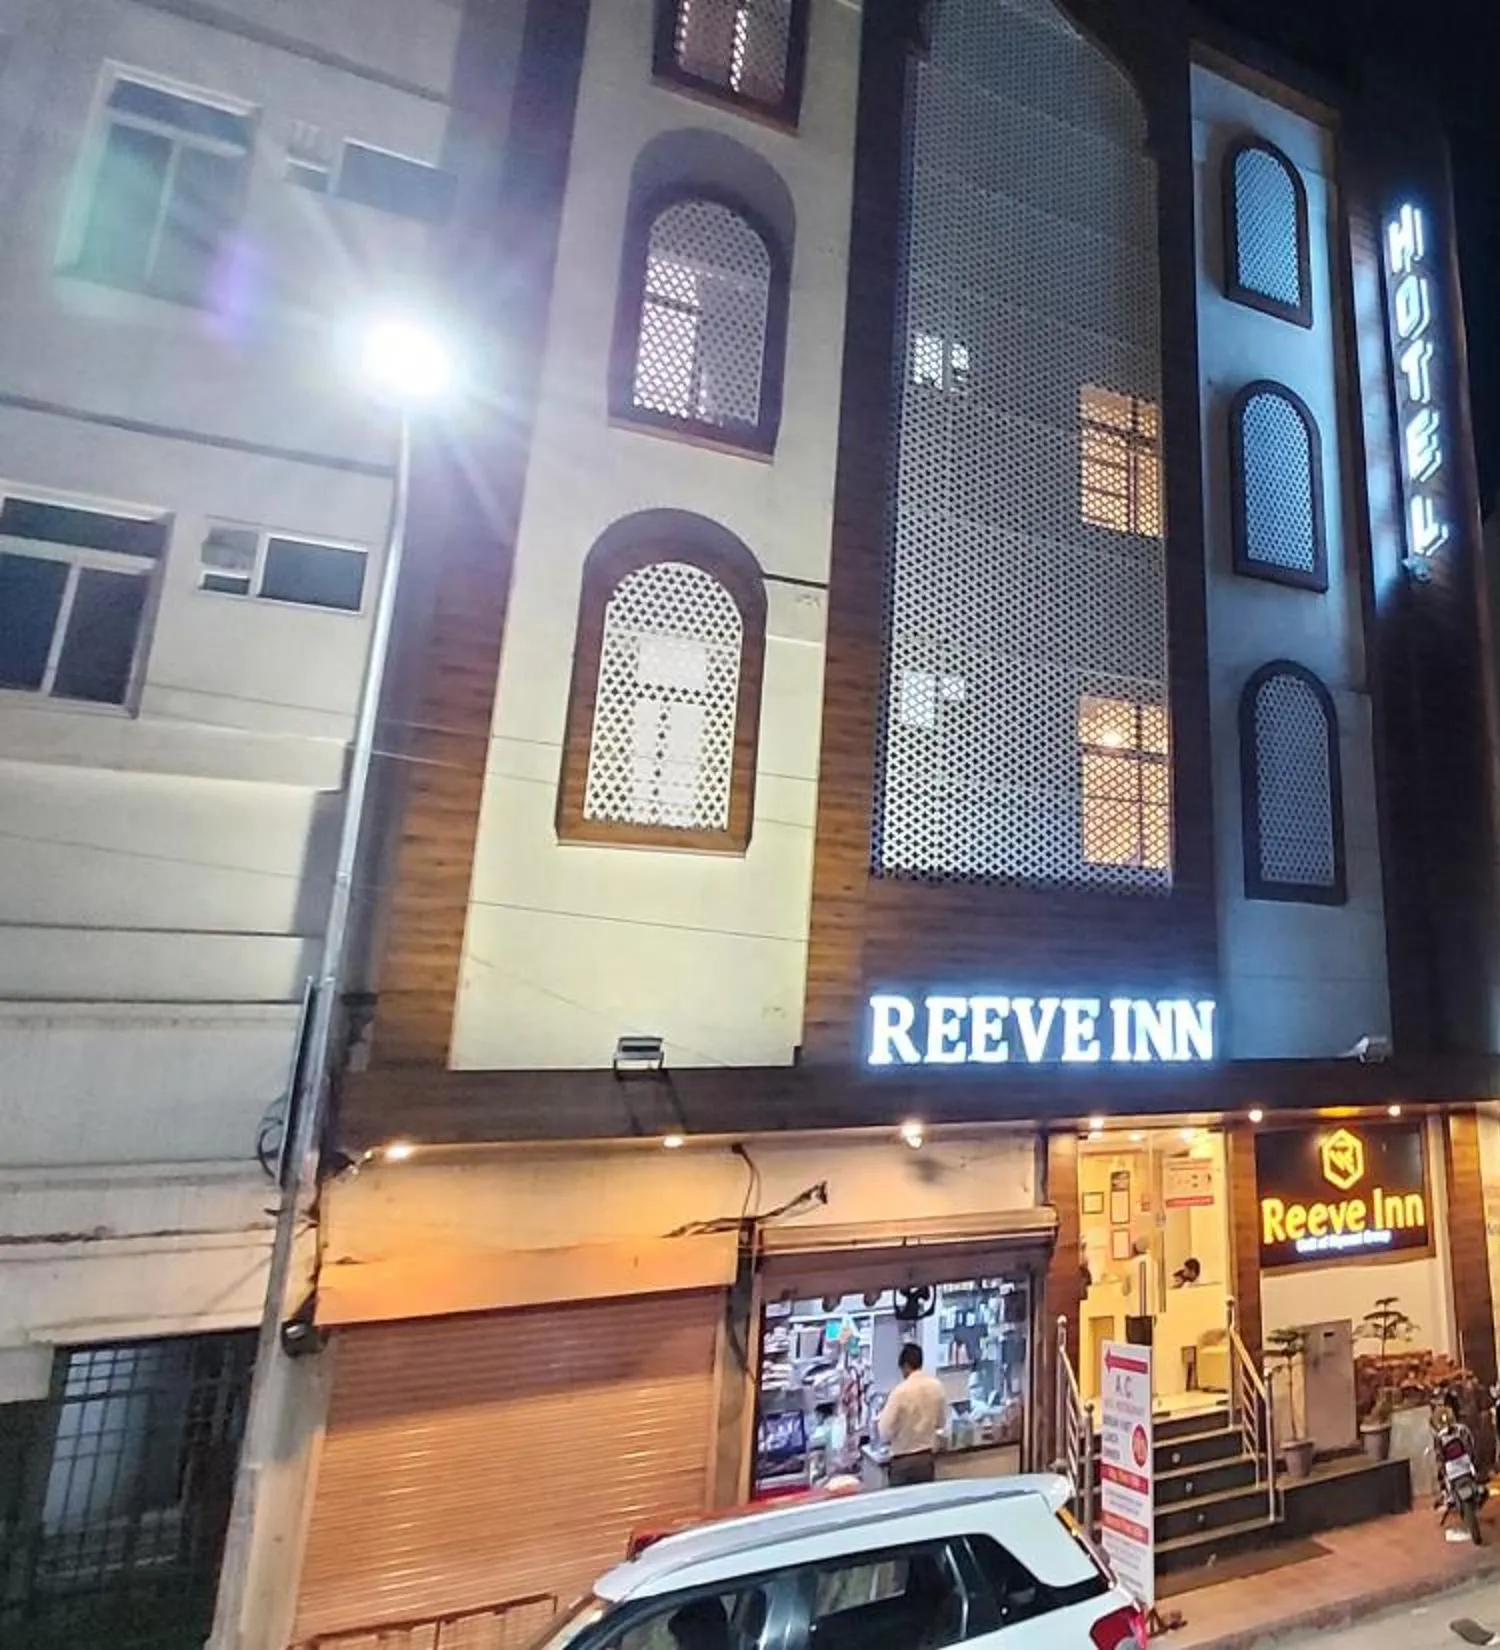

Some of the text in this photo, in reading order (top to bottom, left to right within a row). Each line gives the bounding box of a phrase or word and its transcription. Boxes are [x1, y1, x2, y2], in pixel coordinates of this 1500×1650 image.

[1388, 203, 1448, 556] HOTEL
[868, 995, 1217, 1064] REEVE INN
[1261, 1187, 1425, 1245] Reeve Inn
